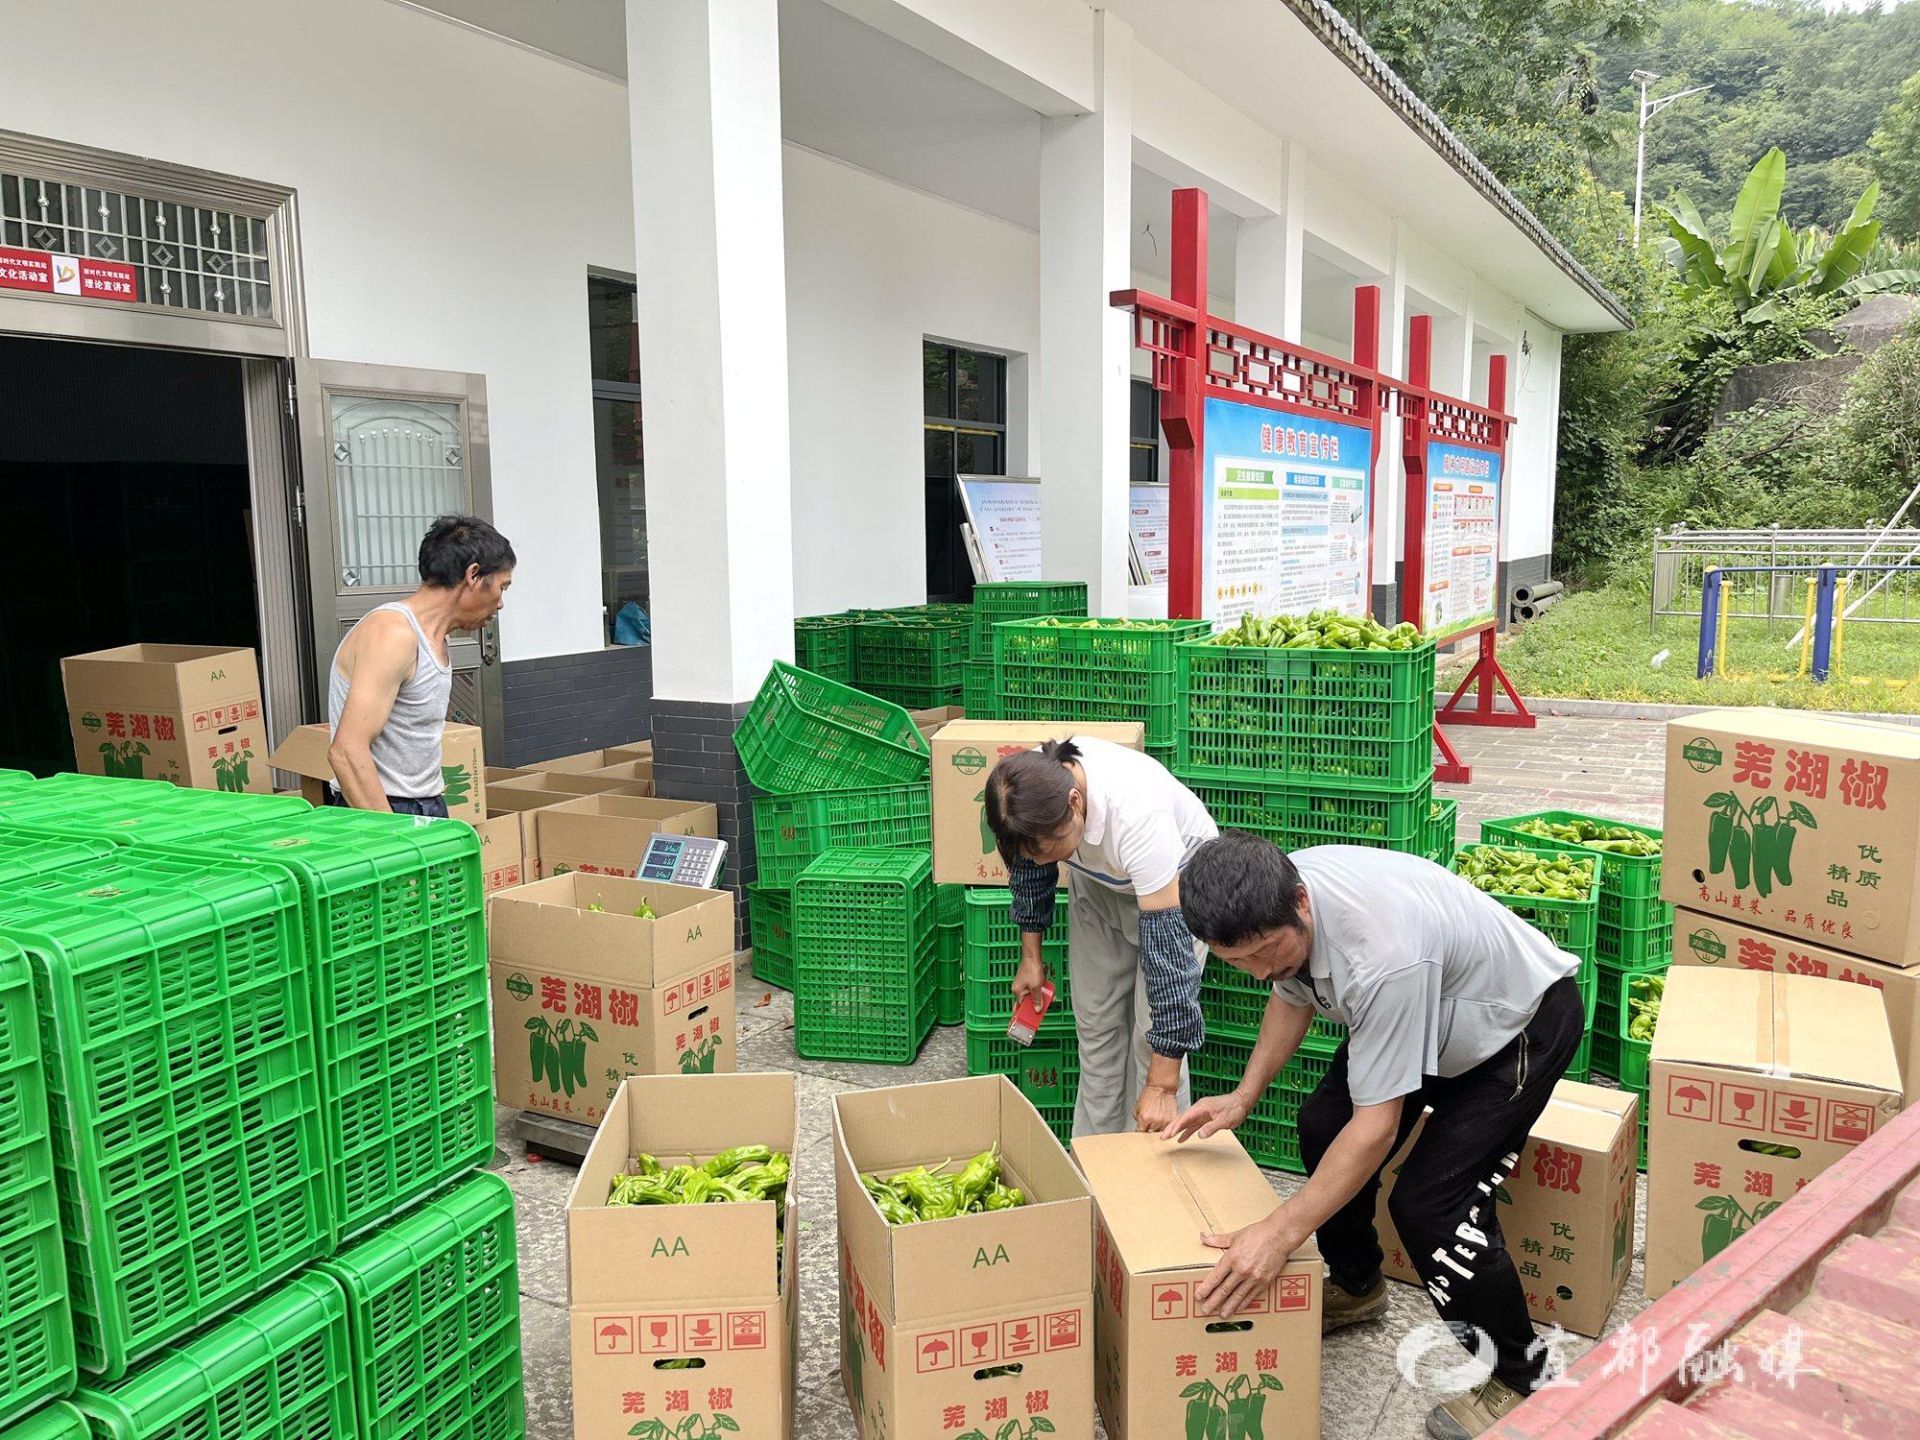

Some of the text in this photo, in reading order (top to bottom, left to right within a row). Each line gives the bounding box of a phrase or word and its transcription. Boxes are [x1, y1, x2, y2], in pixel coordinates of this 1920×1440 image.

[0, 267, 49, 283] 文化活动室
[84, 278, 132, 294] 理论宣讲室
[1261, 424, 1340, 461] 健康教育宣传栏
[210, 669, 227, 681] AA
[105, 712, 177, 741] 芜湖椒
[207, 737, 252, 760] 芜湖椒
[1733, 740, 1889, 811] 芜湖椒
[1855, 844, 1883, 891] 优质
[1826, 864, 1852, 908] 精品
[686, 925, 703, 943] AA
[540, 976, 639, 1028] 芜湖椒
[676, 1017, 720, 1050] 芜湖椒
[651, 1236, 690, 1258] AA
[972, 1243, 1010, 1269] AA
[1550, 1221, 1576, 1264] 优质
[1519, 1237, 1545, 1279] 精品
[1175, 1348, 1279, 1377] 芜湖椒
[622, 1387, 733, 1414] 芜湖椒
[943, 1390, 1049, 1430] 芜湖椒
